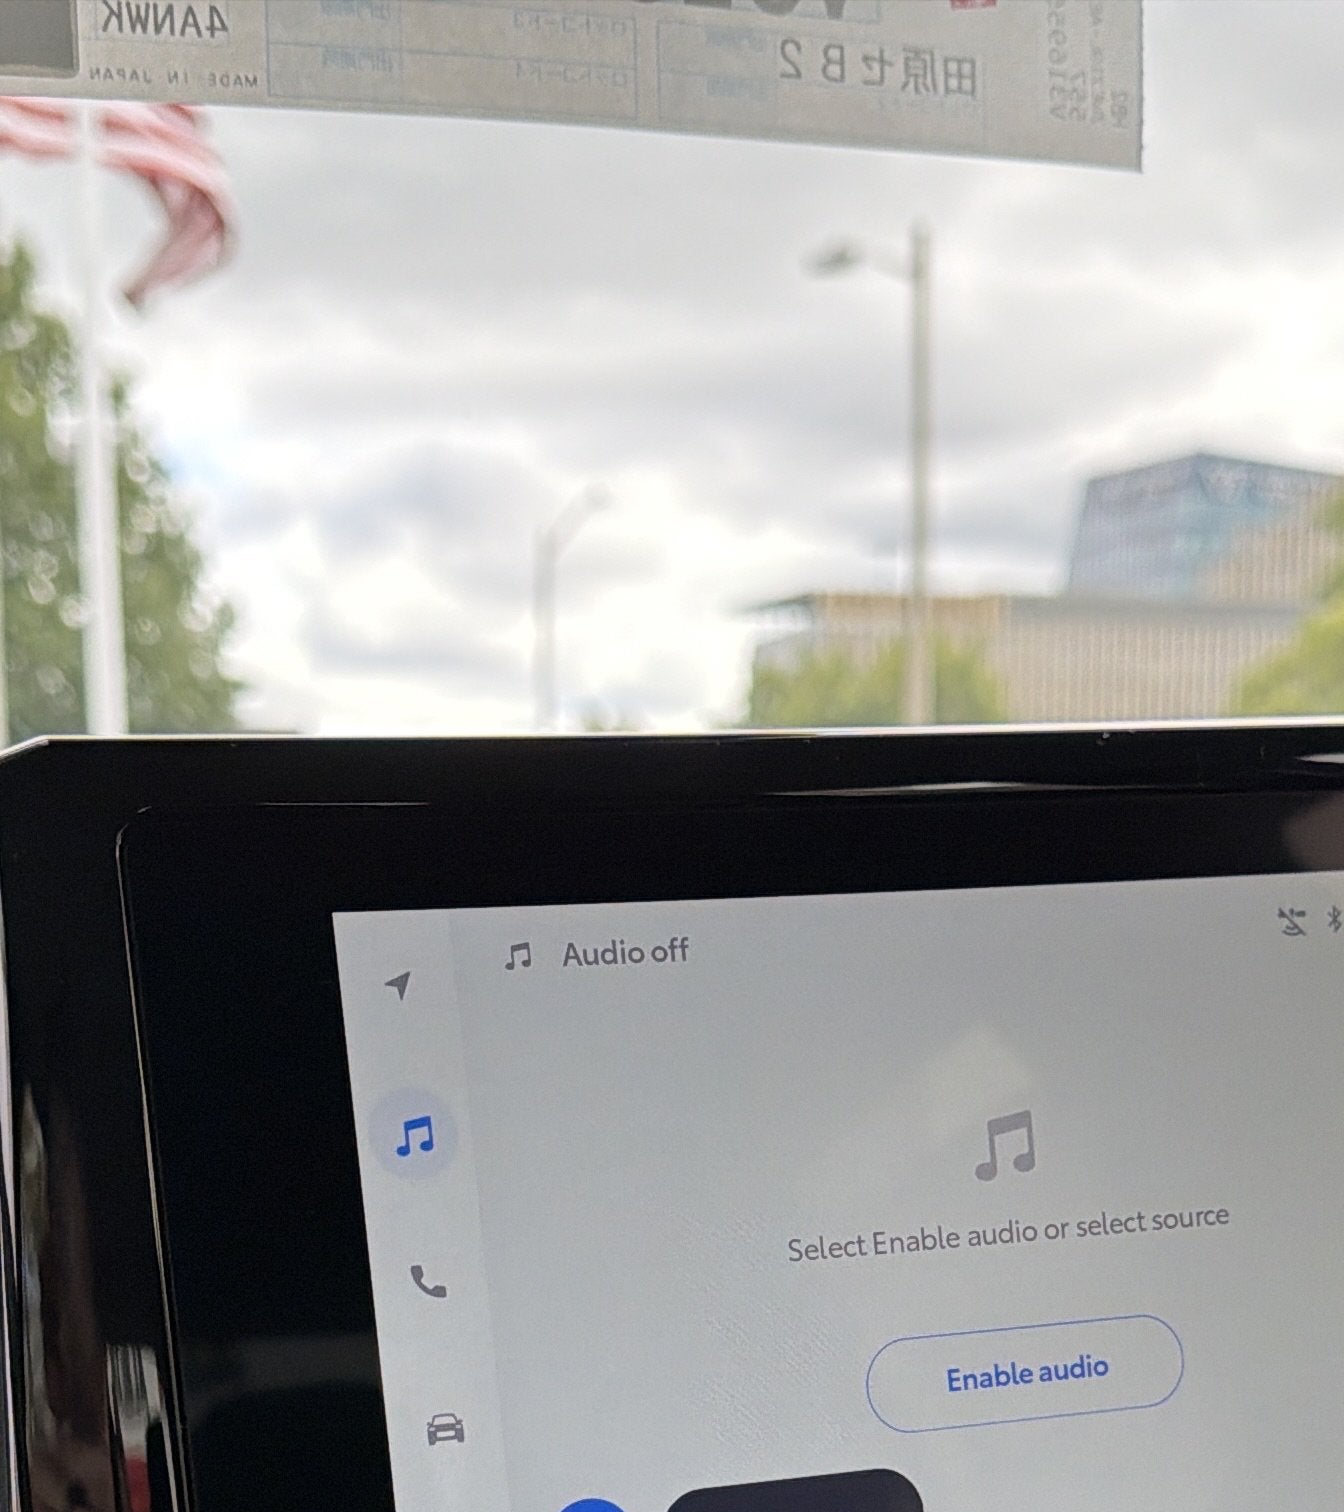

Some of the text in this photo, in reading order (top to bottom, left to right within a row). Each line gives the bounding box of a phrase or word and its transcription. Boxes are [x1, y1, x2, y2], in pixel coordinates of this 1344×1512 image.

[562, 935, 690, 969] Audio off
[788, 1206, 1230, 1263] Select Enable audio or select source
[946, 1355, 1109, 1392] Enable audio
